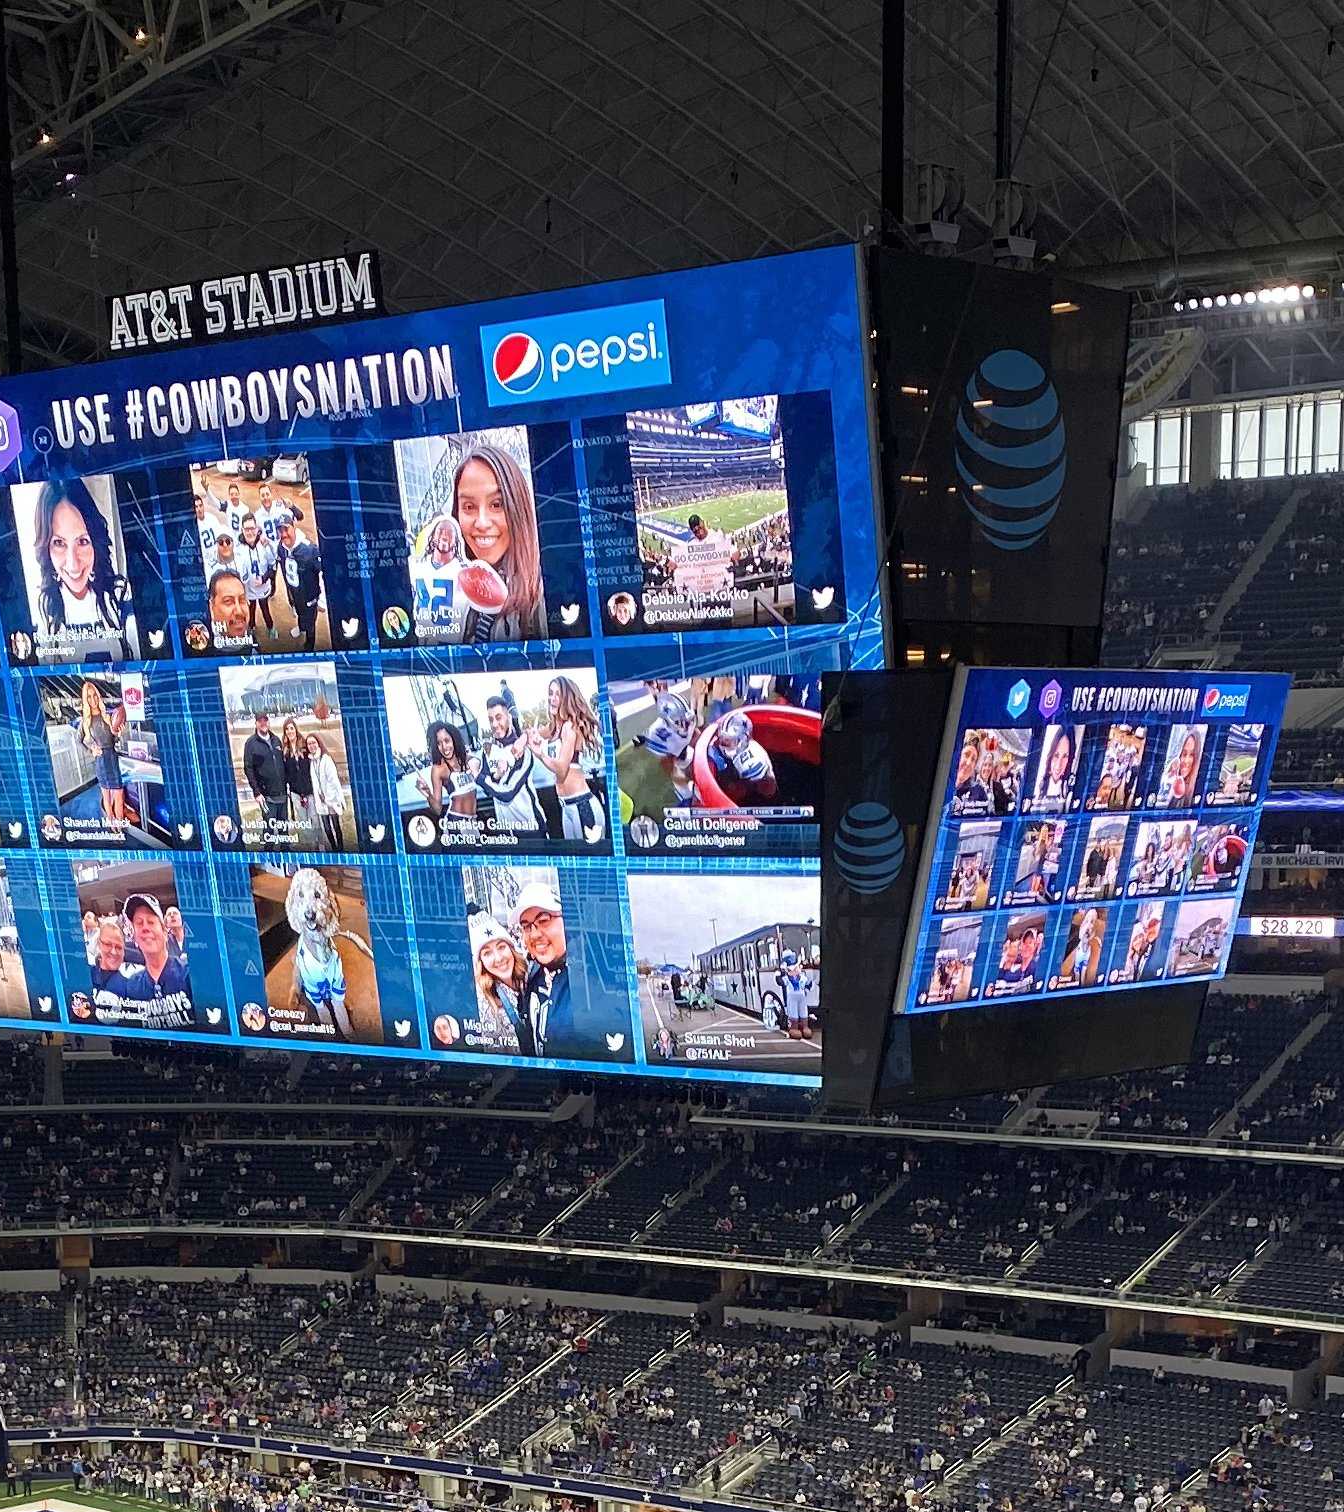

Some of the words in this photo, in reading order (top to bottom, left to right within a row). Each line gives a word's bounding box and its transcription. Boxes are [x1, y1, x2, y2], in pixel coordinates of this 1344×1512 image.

[109, 285, 192, 350] AT&T
[205, 253, 377, 335] STADIUM
[551, 322, 657, 383] pepsi
[52, 393, 116, 449] USE
[126, 344, 454, 440] #COWBOYSNATION
[641, 592, 685, 606] Debbie
[1071, 687, 1096, 712] USE
[1096, 687, 1199, 712] #COWBOYSNATION
[1219, 693, 1249, 710] pepsi
[1261, 856, 1273, 867] 88
[1276, 856, 1322, 867] MICHAEL
[1261, 919, 1323, 936] $28,220
[684, 1032, 721, 1046] Susan
[723, 1034, 756, 1048] Short
